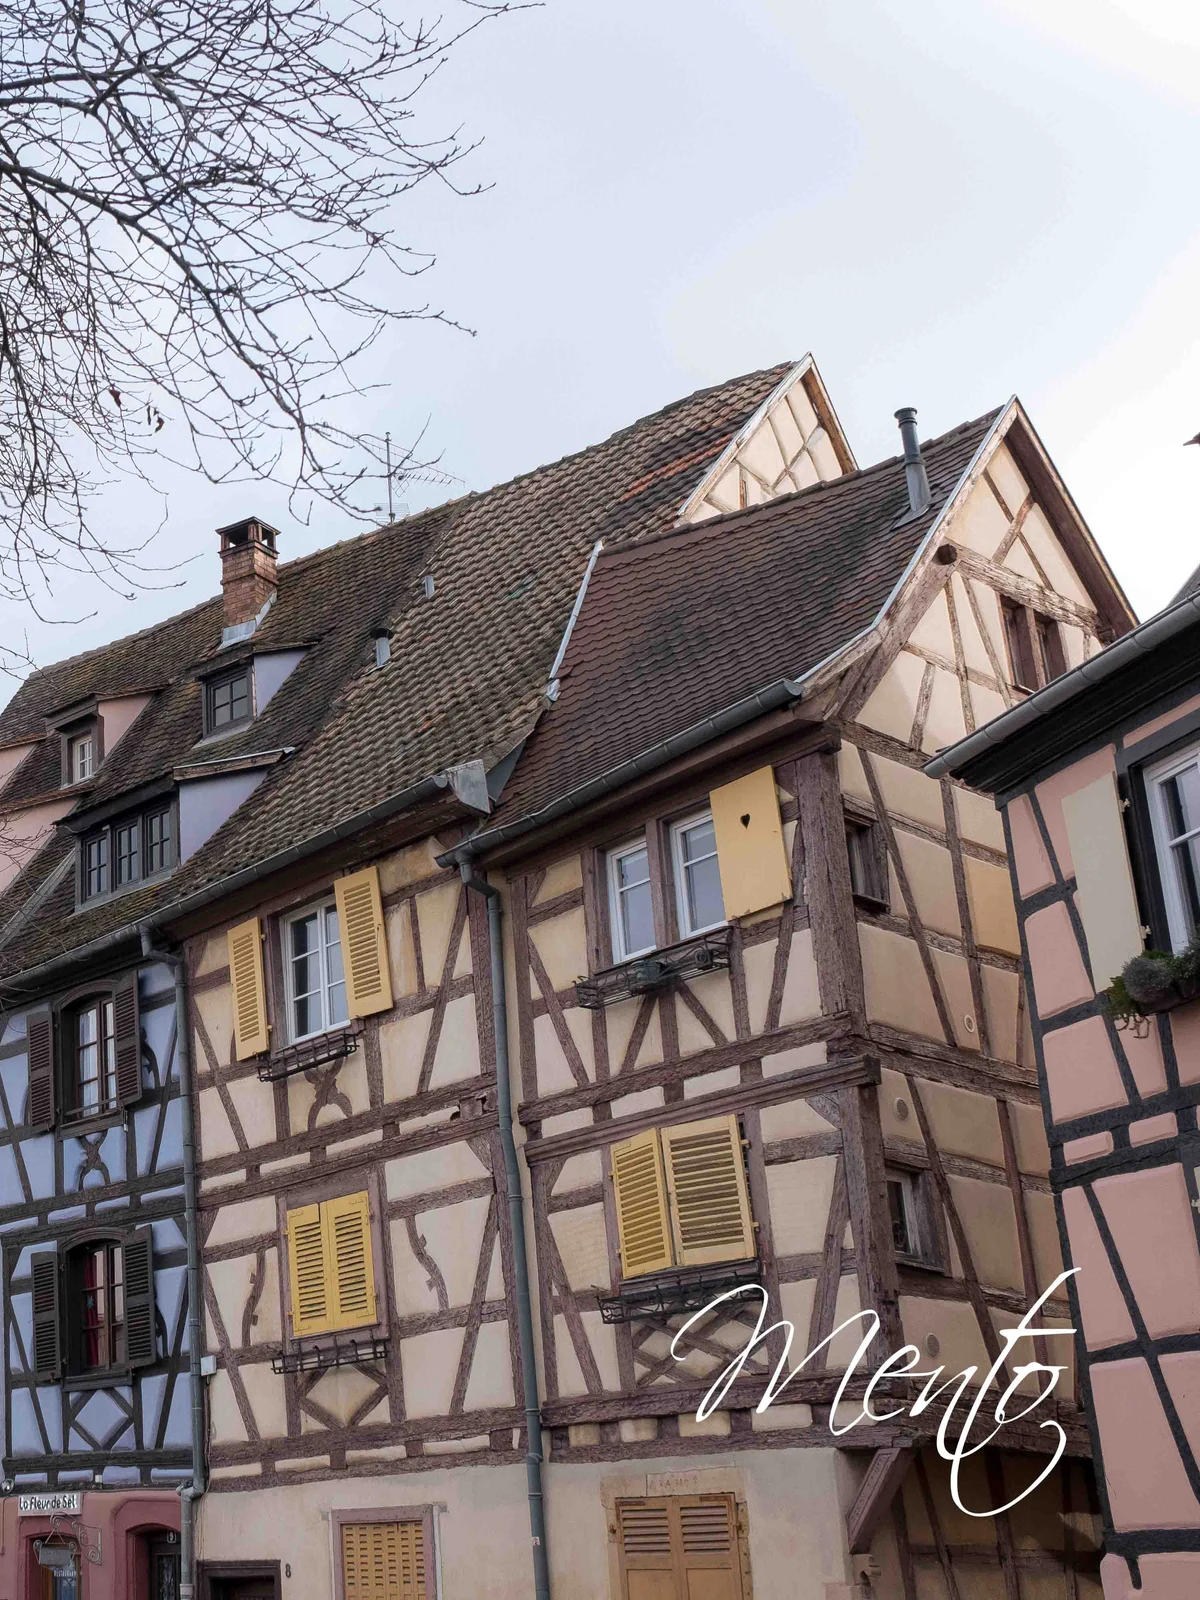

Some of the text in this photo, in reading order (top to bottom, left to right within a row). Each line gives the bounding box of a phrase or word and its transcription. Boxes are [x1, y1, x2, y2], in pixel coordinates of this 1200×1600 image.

[51, 1495, 61, 1509] de
[62, 1494, 76, 1508] Sel
[285, 1563, 291, 1578] 8
